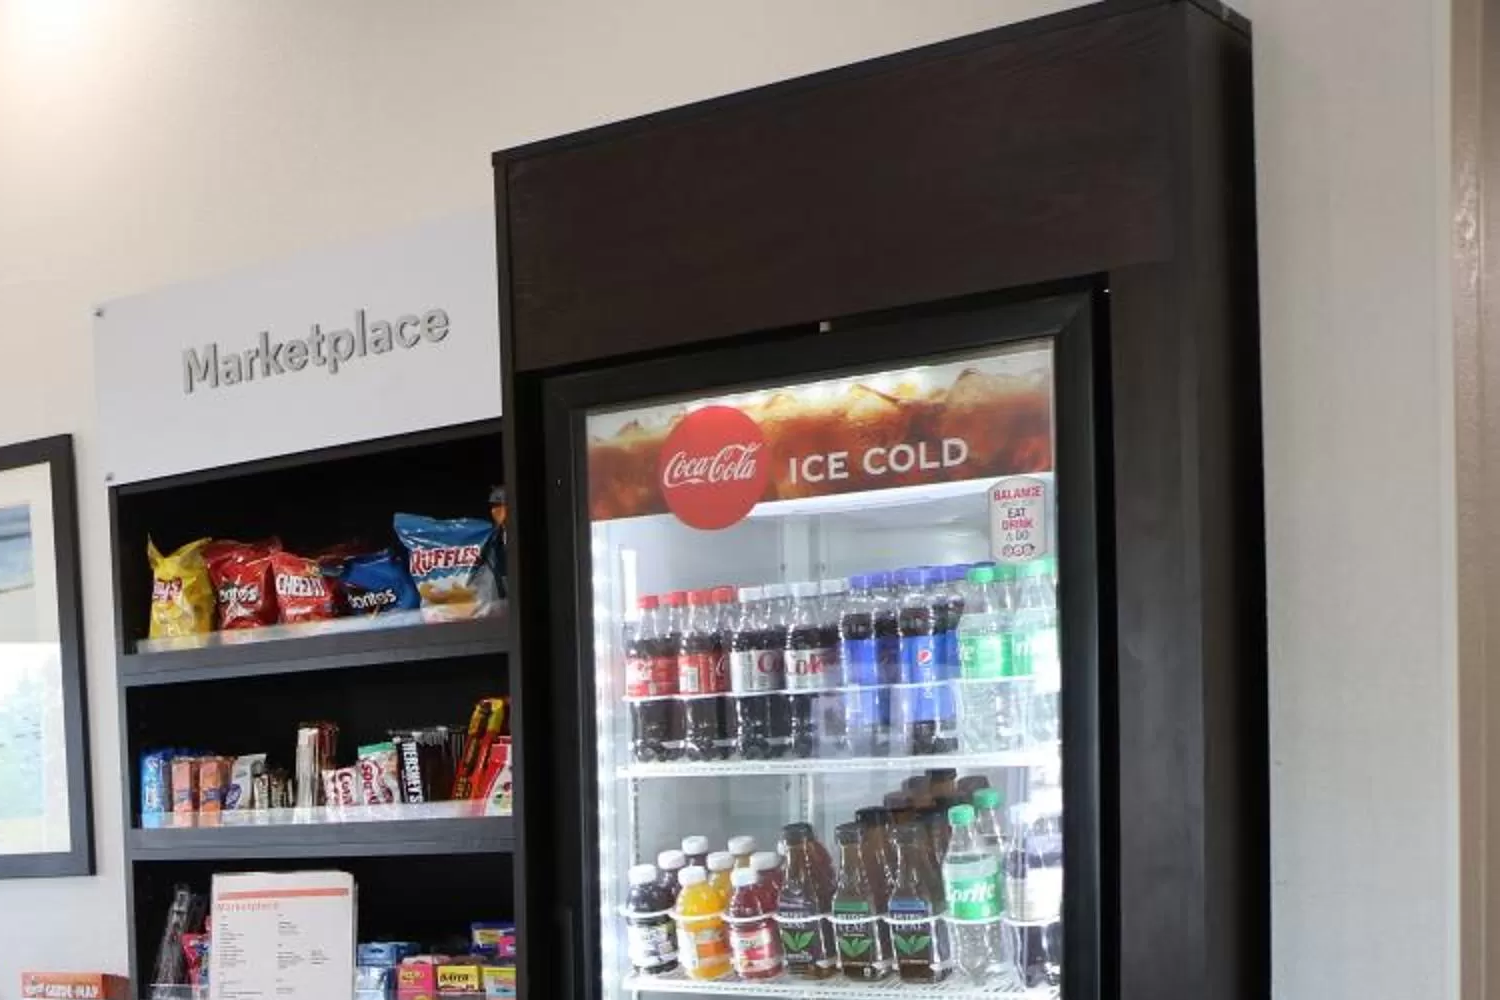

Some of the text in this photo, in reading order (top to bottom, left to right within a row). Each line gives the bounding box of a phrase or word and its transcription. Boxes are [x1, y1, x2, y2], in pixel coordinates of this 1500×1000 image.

[181, 305, 451, 394] Marketplace
[789, 437, 969, 483] ICE COLD
[1007, 507, 1026, 518] EAT
[410, 545, 482, 576] RUFFLES
